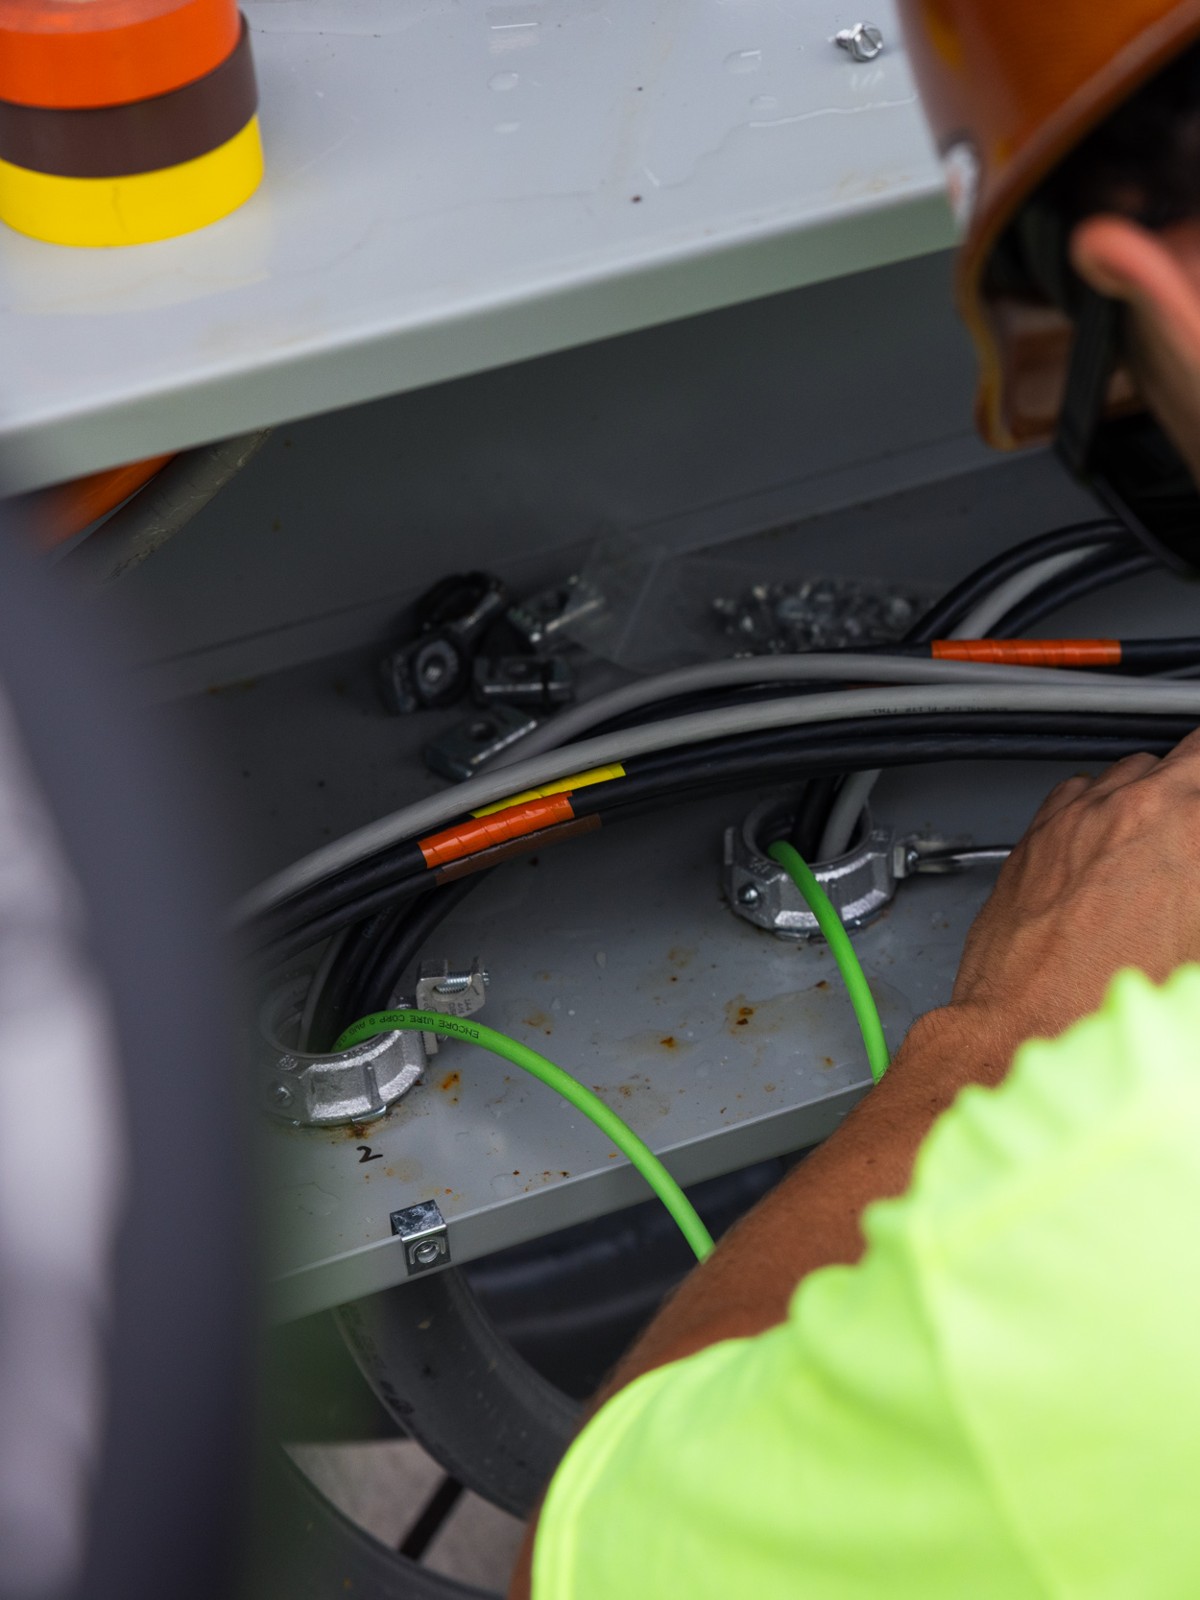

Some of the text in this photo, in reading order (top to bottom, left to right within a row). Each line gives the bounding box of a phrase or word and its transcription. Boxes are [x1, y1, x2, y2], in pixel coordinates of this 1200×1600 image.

[379, 1014, 405, 1023] CORP
[410, 1014, 434, 1025] WIRE
[439, 1020, 480, 1039] ENCORE
[356, 1145, 383, 1162] 2
